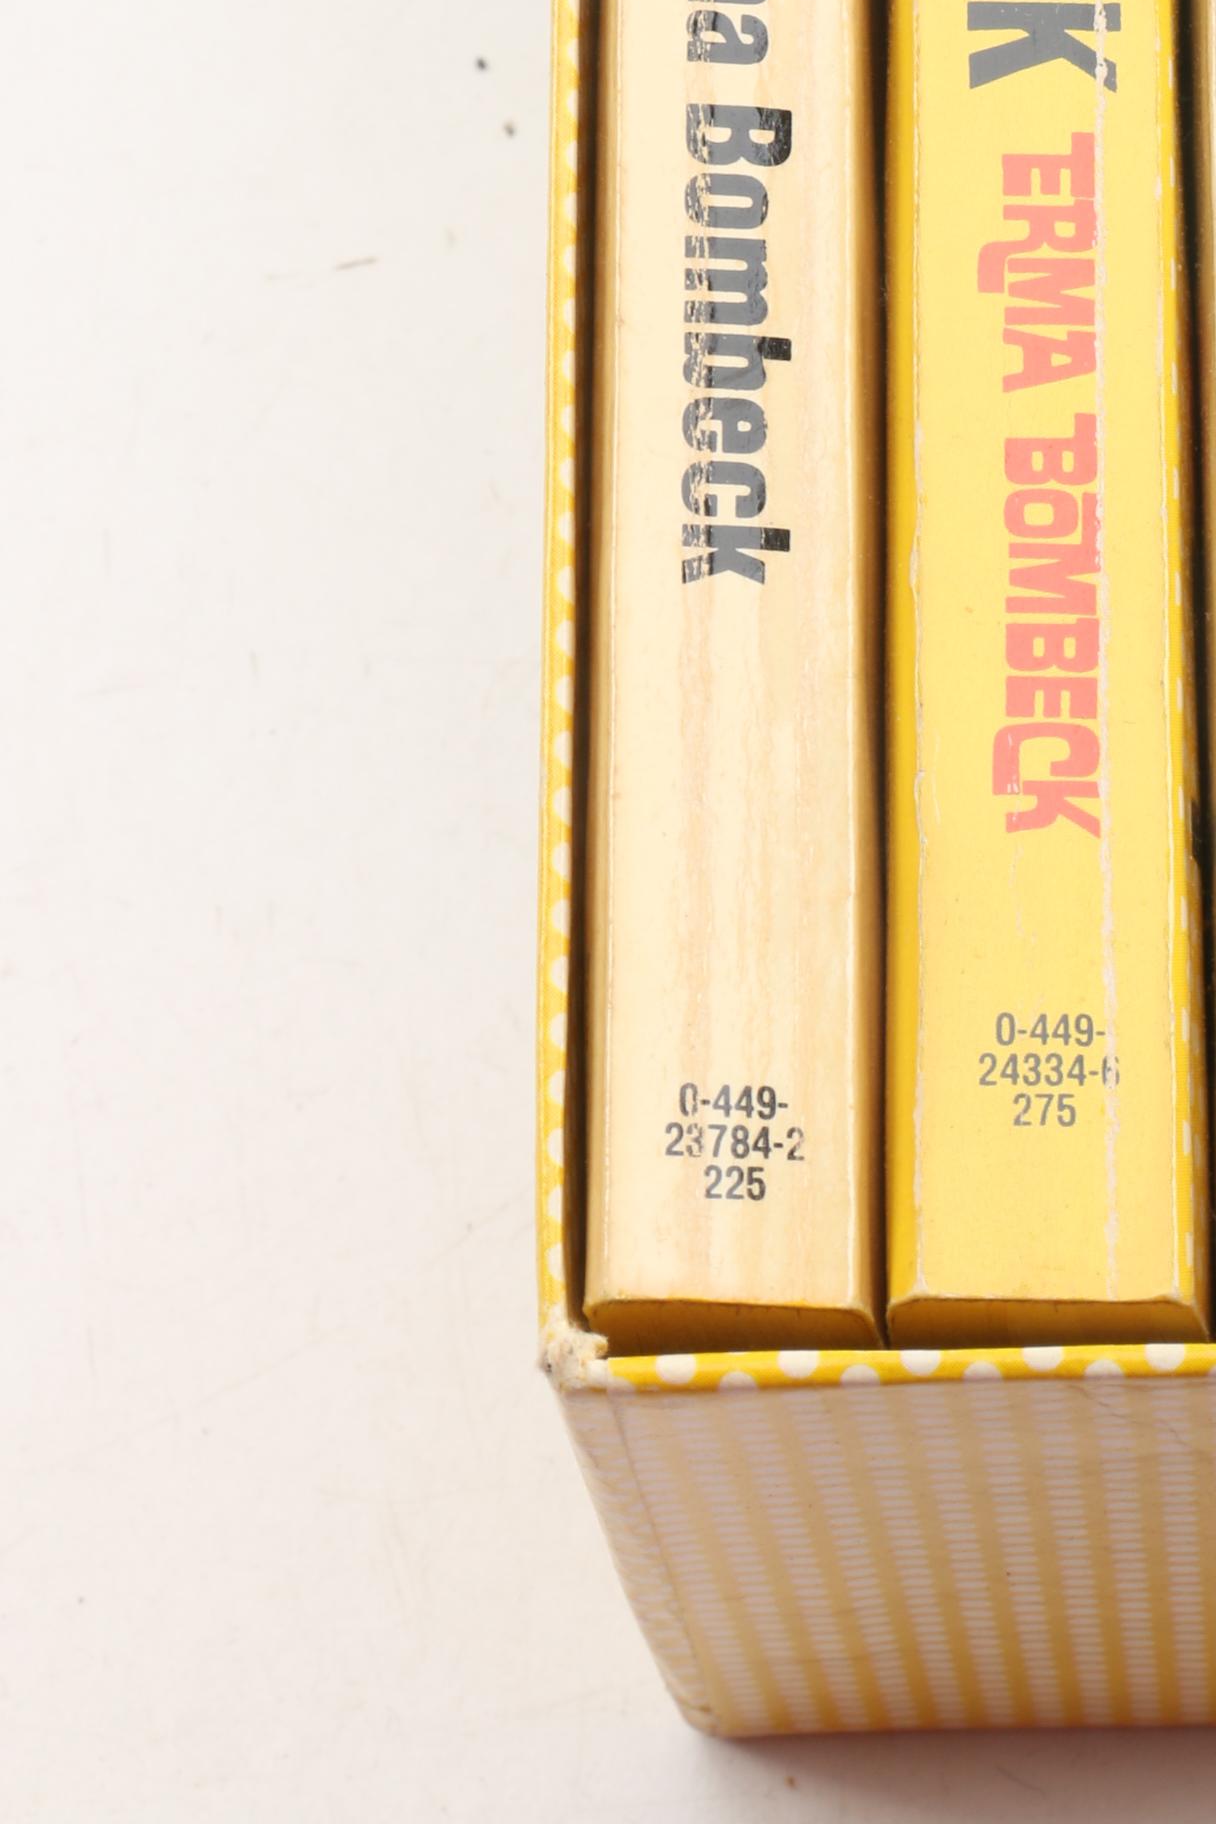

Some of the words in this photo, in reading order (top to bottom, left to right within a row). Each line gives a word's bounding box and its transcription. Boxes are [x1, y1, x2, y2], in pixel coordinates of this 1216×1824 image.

[977, 132, 1098, 392] ERMA
[681, 104, 792, 585] Bombeck
[992, 413, 1101, 838] BOMBECK
[995, 1012, 1106, 1047] 0-449-
[678, 1082, 788, 1120] 0-449-
[1013, 1093, 1076, 1127] 275
[665, 1122, 805, 1161] 23784-2
[704, 1164, 766, 1201] 225
